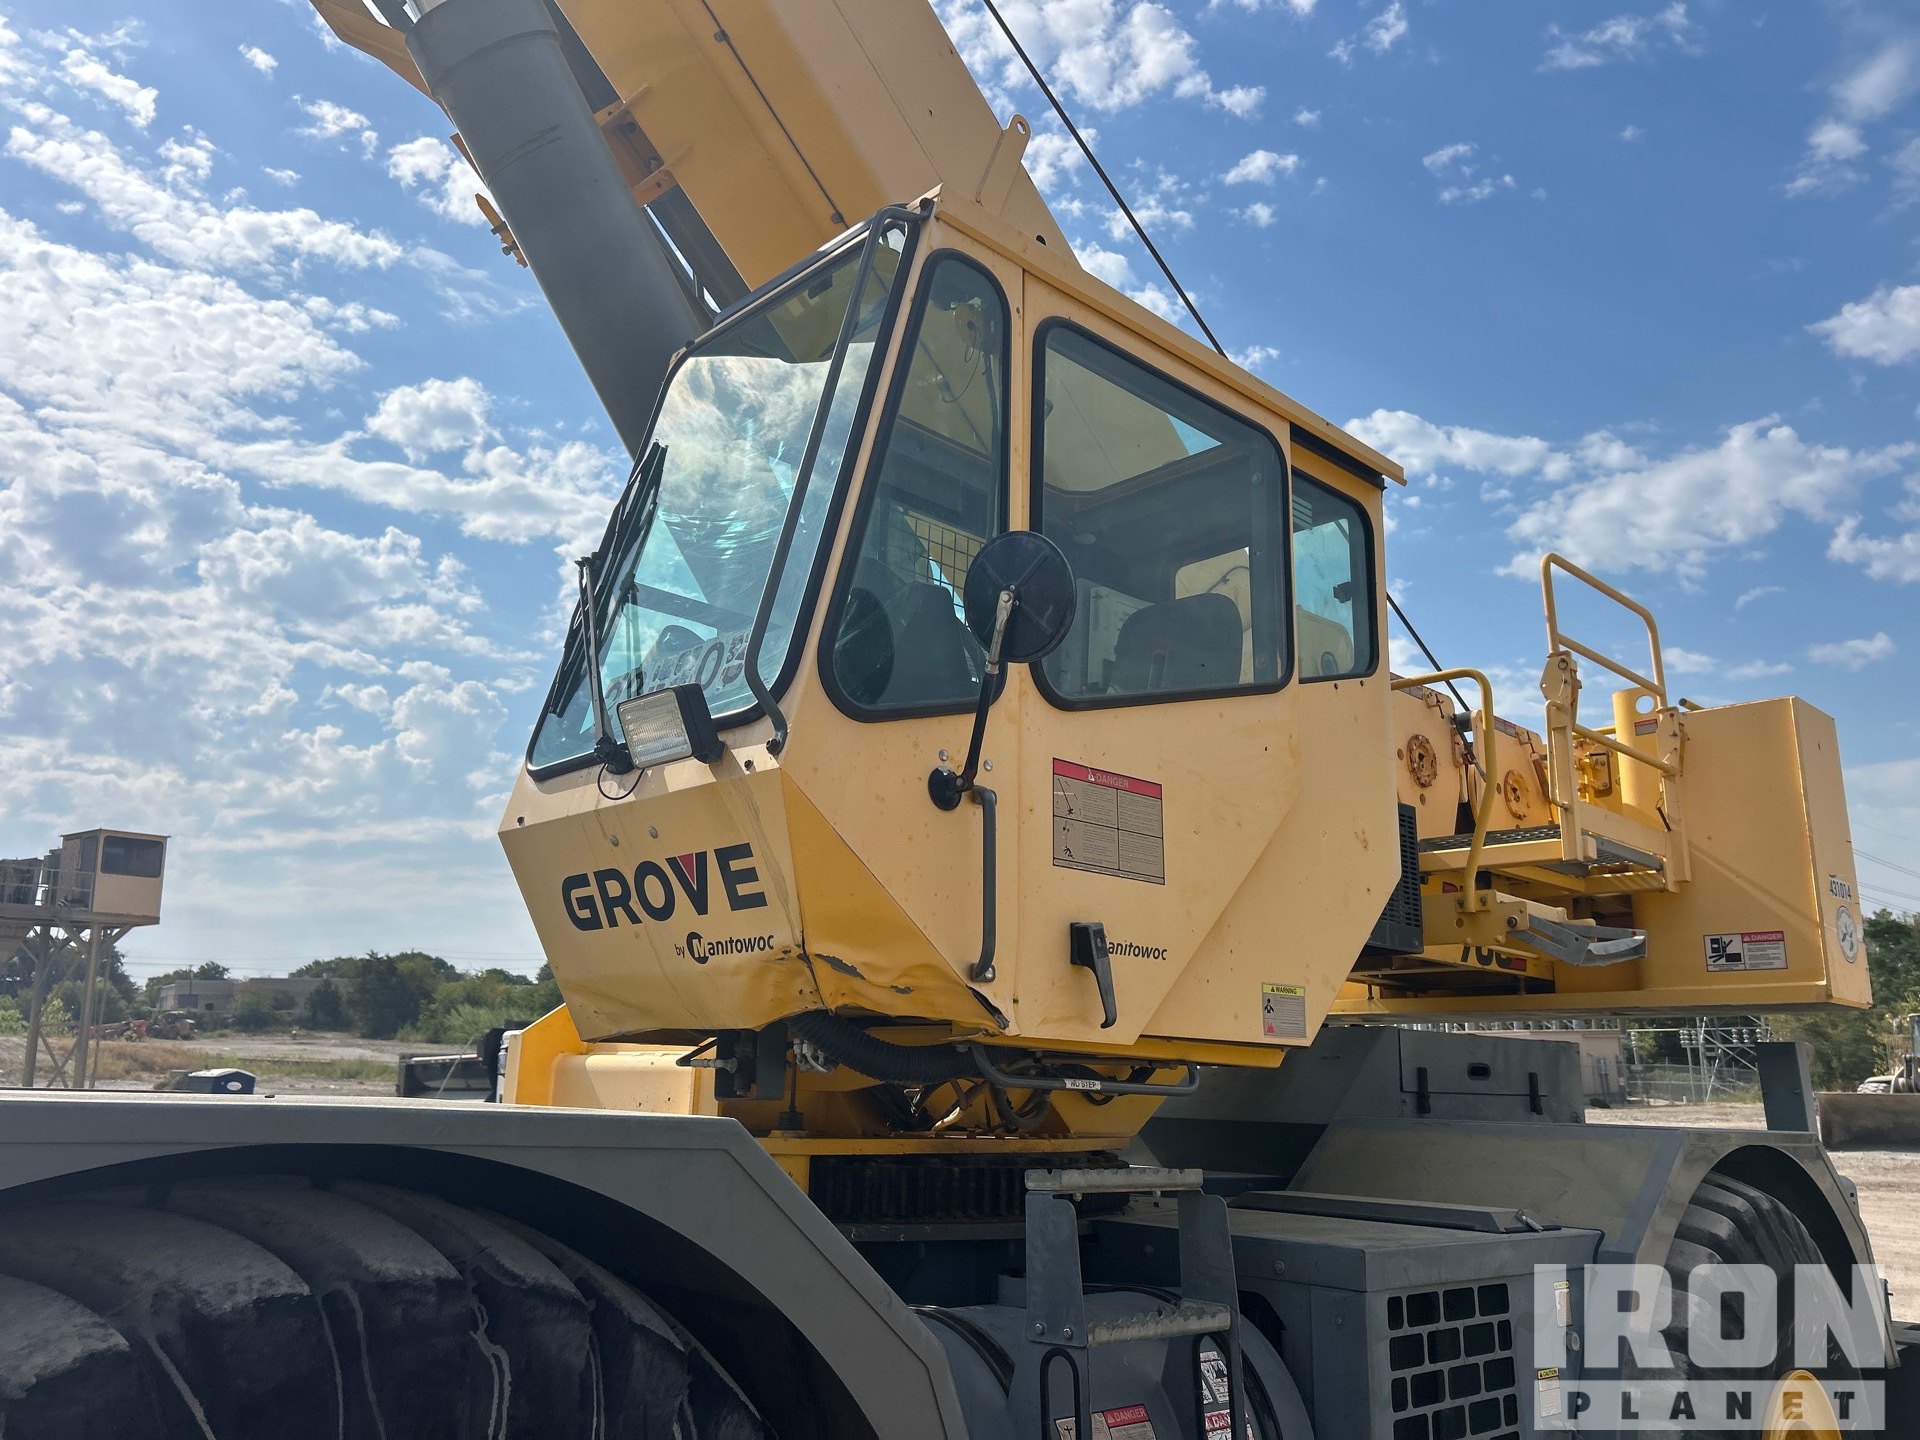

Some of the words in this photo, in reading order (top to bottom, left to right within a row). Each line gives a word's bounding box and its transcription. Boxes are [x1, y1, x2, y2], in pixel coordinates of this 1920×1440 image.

[1096, 773, 1129, 789] DANGER
[561, 842, 768, 931] GROVE
[674, 943, 686, 959] by
[686, 931, 775, 964] Manitowoc
[1108, 941, 1168, 960] anitowoc
[1276, 986, 1297, 995] WARNING
[1115, 1406, 1147, 1422] DANGER
